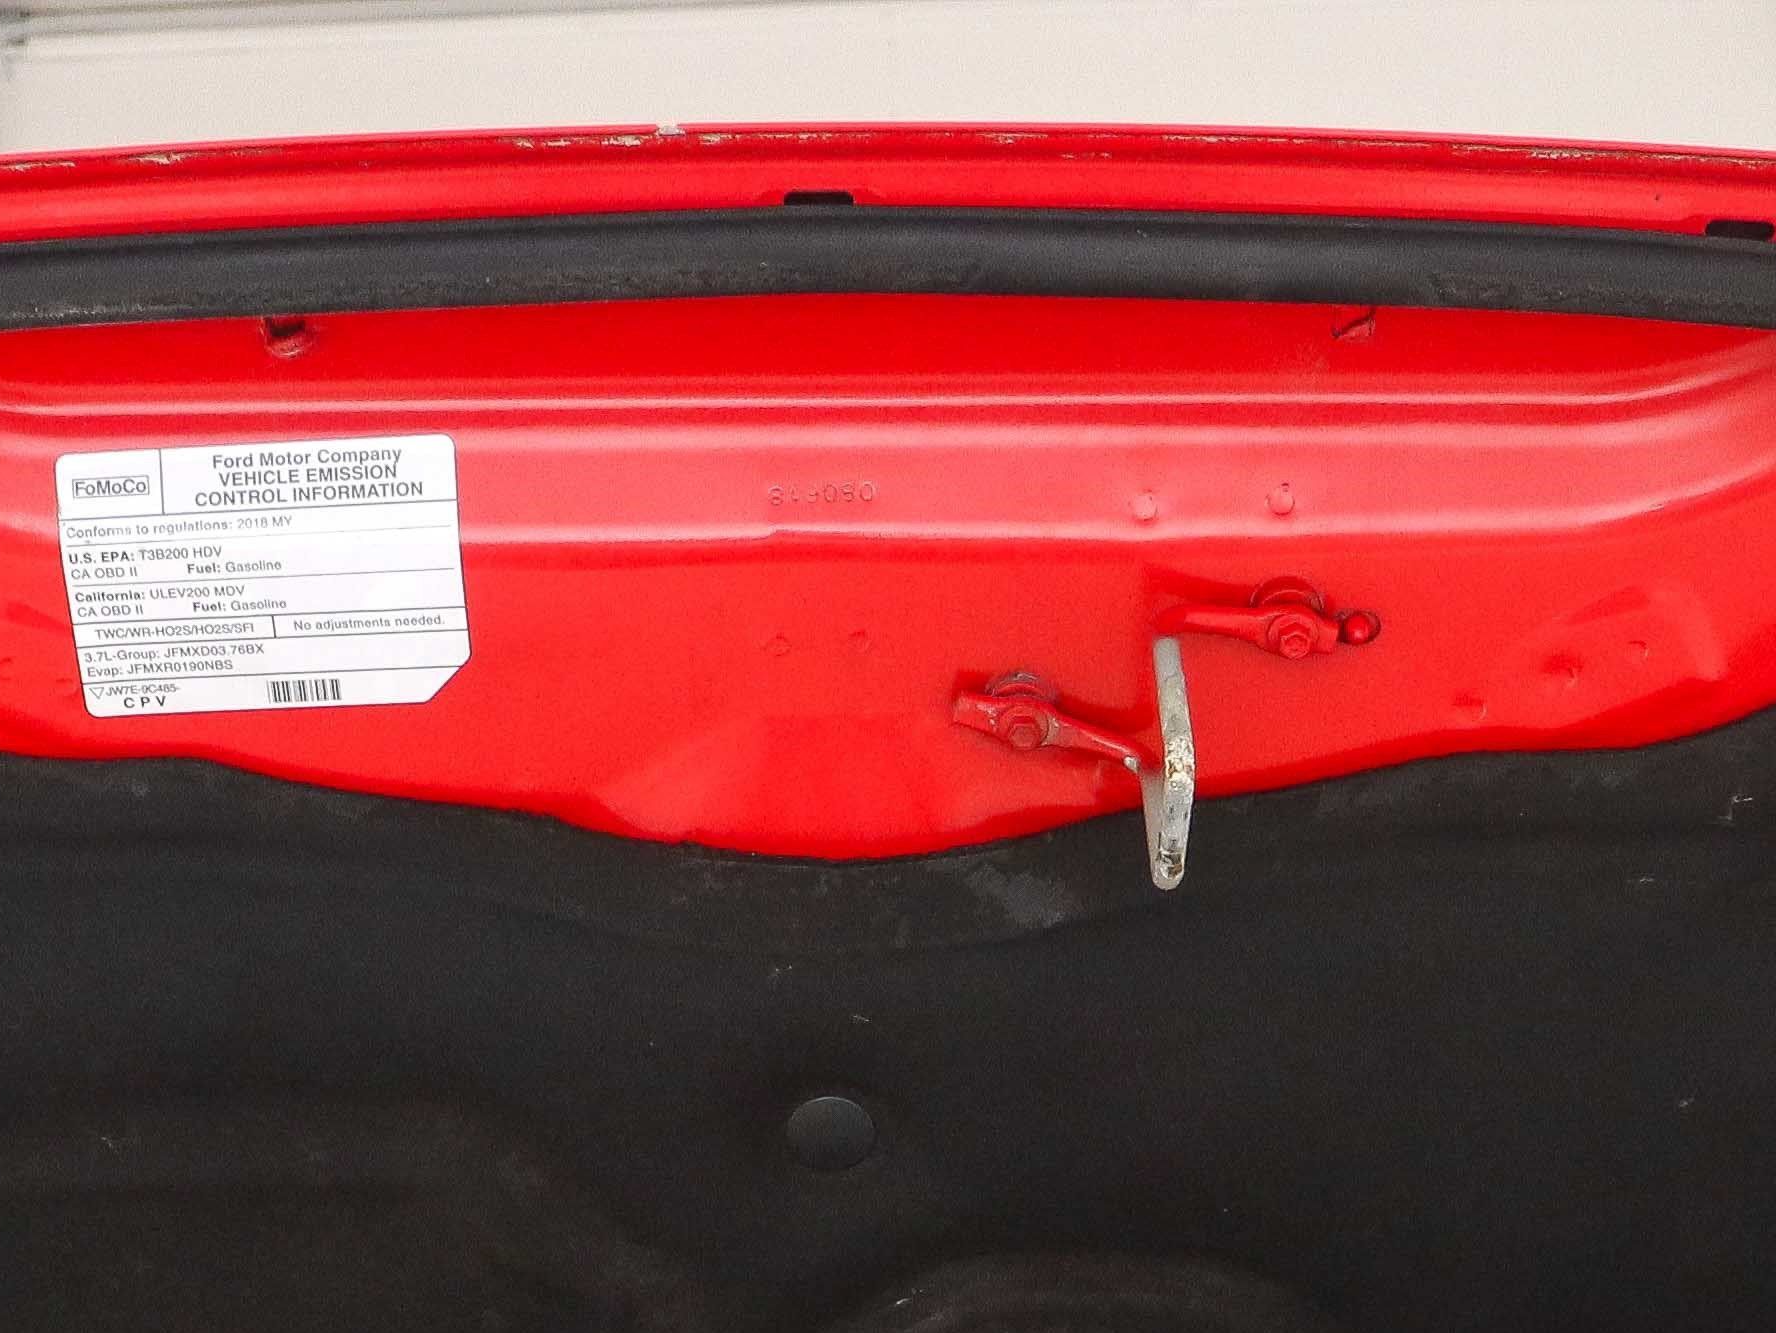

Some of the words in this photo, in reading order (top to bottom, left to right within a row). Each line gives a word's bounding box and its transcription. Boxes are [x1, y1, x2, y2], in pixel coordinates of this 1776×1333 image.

[213, 454, 253, 469] Ford
[260, 452, 312, 467] Motor
[317, 449, 402, 465] Company
[218, 469, 300, 487] VEHICLE
[306, 464, 398, 483] EMISSION
[74, 479, 147, 497] FoMoCo
[195, 489, 287, 507] CONTROL
[293, 481, 424, 504] INFORMATION
[66, 526, 132, 539] Conforms
[136, 524, 149, 535] to
[153, 520, 233, 537] regulations:
[237, 517, 268, 530] 2018
[272, 516, 293, 527] MY
[69, 552, 97, 565] U.S.
[101, 550, 135, 563] EPA:
[71, 569, 91, 580] CA
[94, 567, 125, 579] OBD
[187, 563, 221, 575] Fuel:
[225, 560, 282, 573] Gasoline
[75, 590, 145, 603] California:
[149, 586, 211, 600] ULEV200
[77, 607, 97, 618] CA
[101, 605, 132, 617] OBD
[193, 601, 227, 613] Fuel:
[230, 599, 287, 611] Gasoline
[293, 619, 312, 631] No
[315, 618, 391, 631] adjustments
[395, 614, 446, 627] needed.
[84, 649, 160, 664] 3.7L-Group:
[86, 665, 124, 679] Evap:
